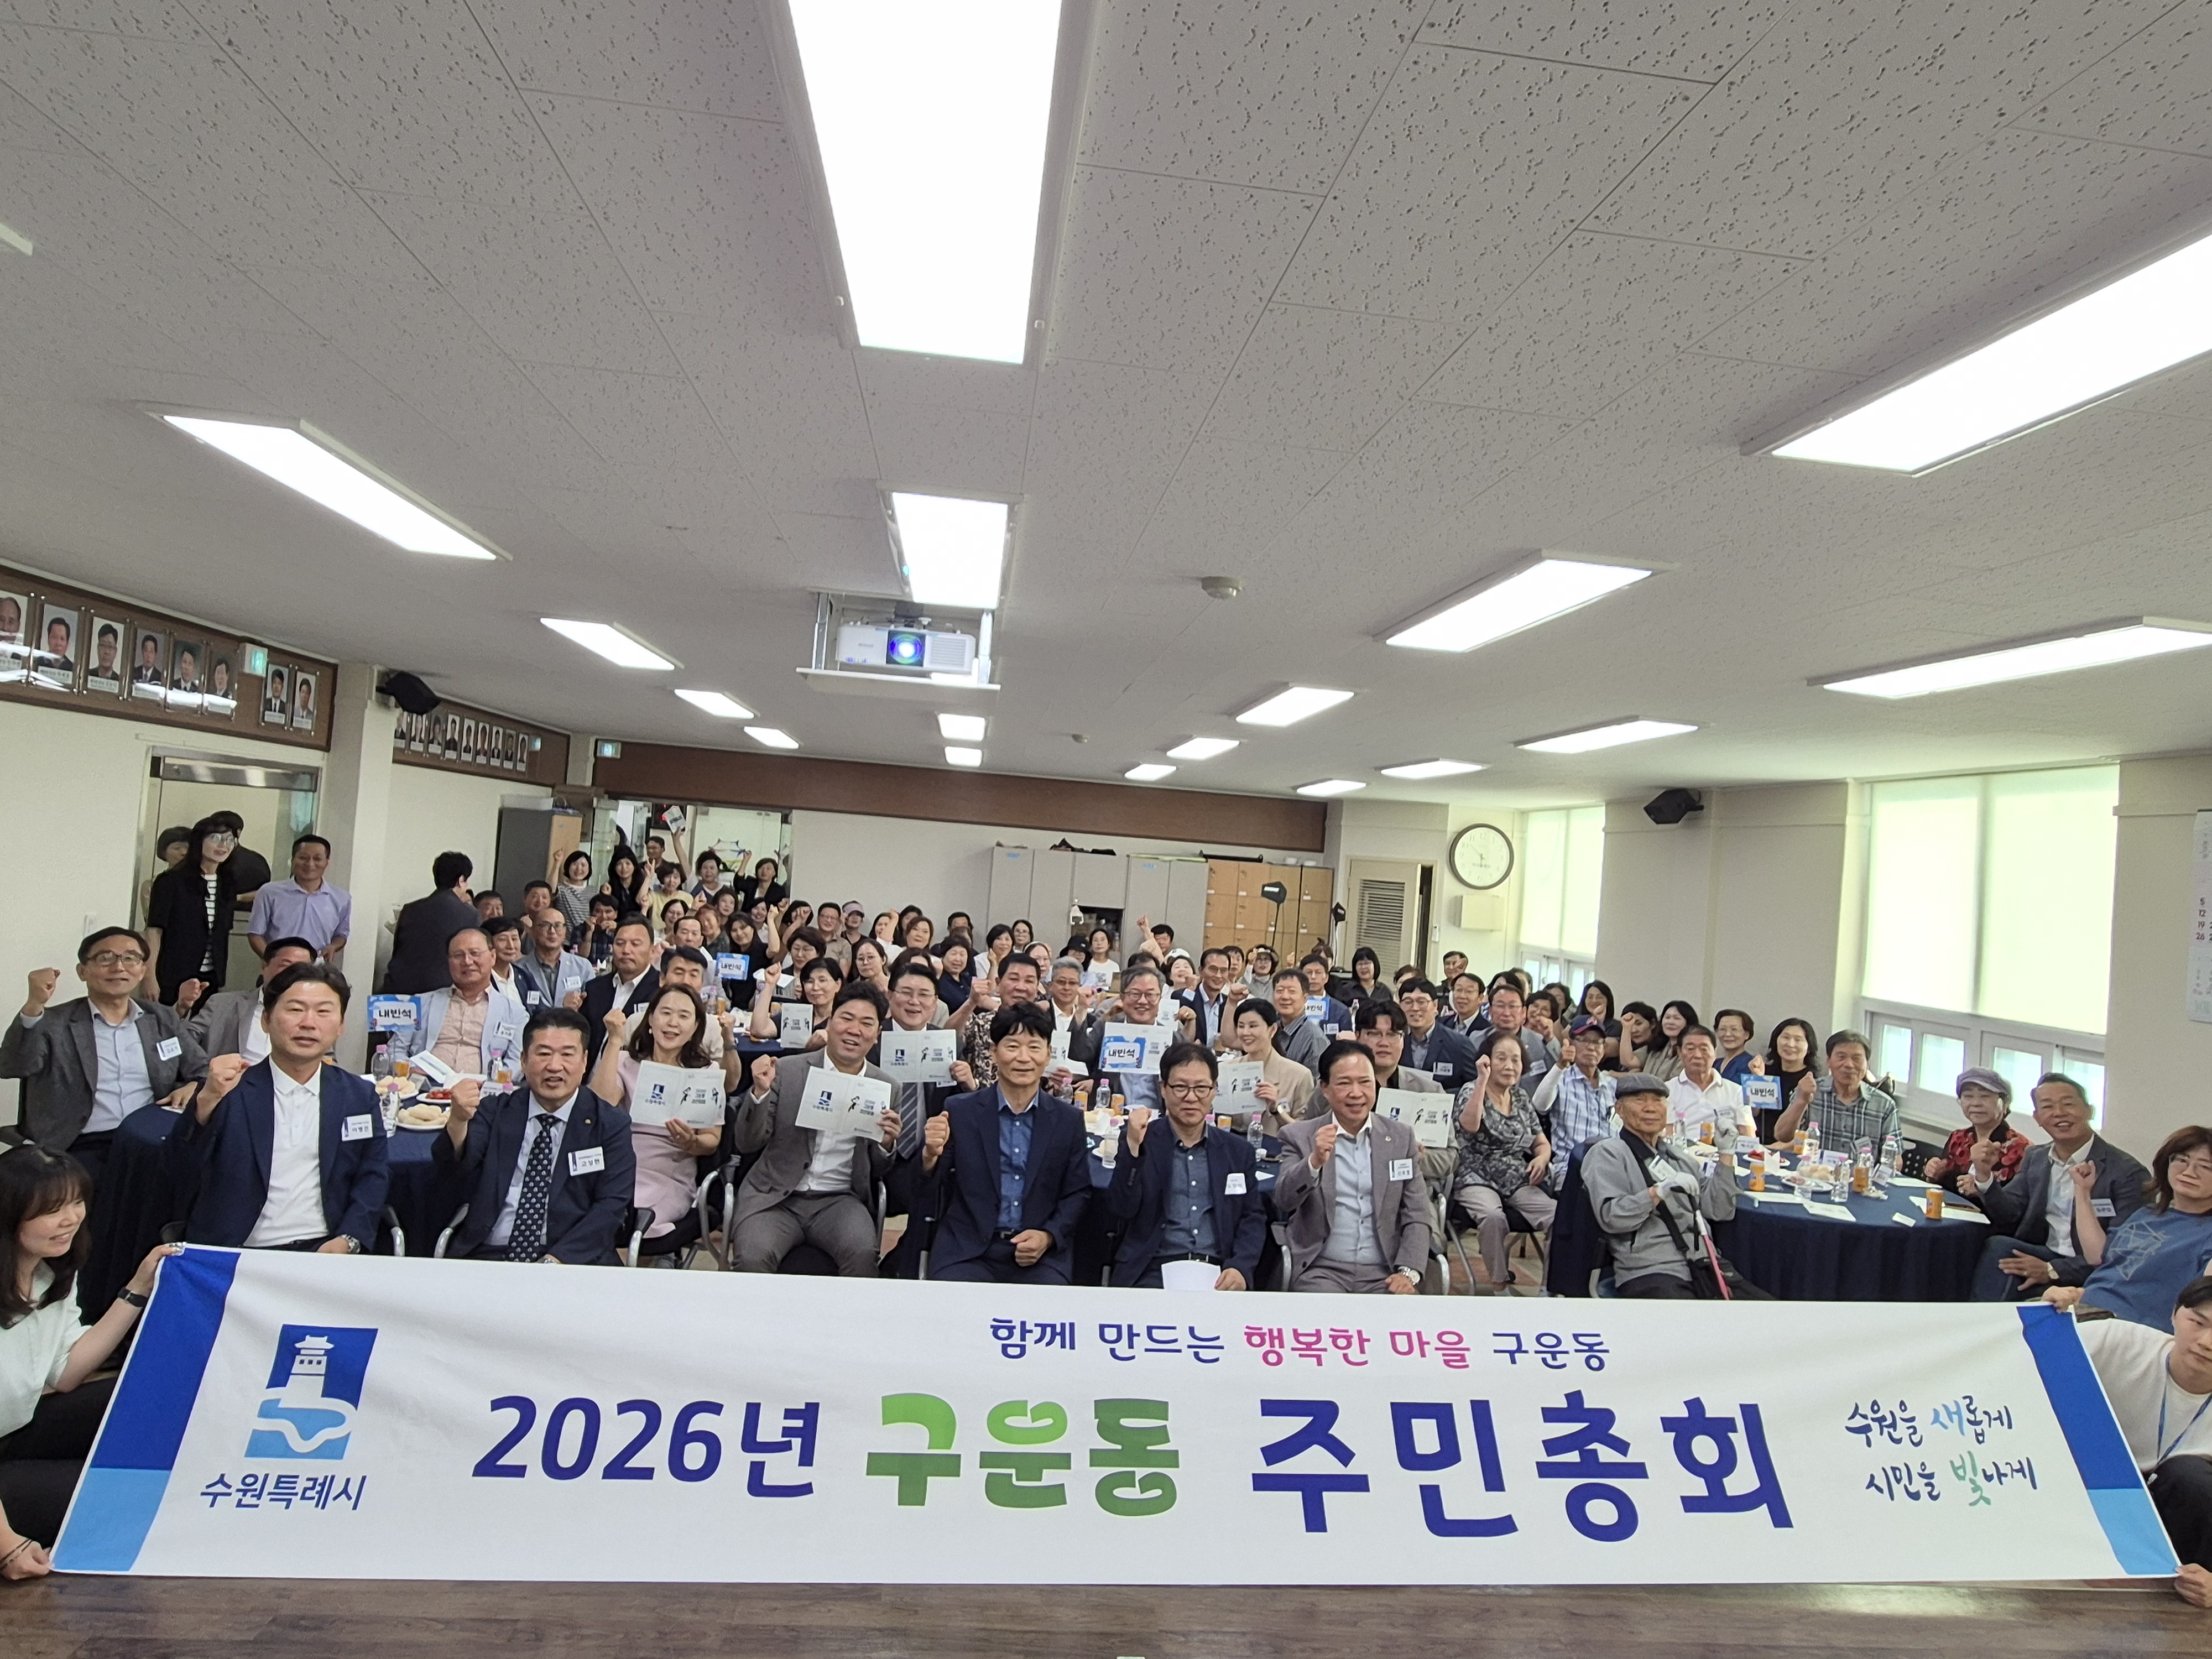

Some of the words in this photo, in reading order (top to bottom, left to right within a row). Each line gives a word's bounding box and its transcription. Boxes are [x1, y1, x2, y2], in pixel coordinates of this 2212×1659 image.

[2195, 932, 2205, 940] 26
[378, 1008, 411, 1019] 내빈석
[1108, 1048, 1135, 1058] 내빈석
[1750, 1087, 1775, 1098] 내빈석
[990, 1318, 1076, 1359] 함께
[1098, 1324, 1224, 1364] 만드는
[1244, 1325, 1371, 1366] 행복한
[1389, 1330, 1471, 1369] 마을
[1493, 1332, 1610, 1371] 구운동
[1845, 1399, 1923, 1448] 수원을
[1931, 1395, 2012, 1444] 새롭게
[472, 1396, 820, 1498] 2026년
[866, 1392, 1180, 1516] 구운동
[1252, 1389, 1793, 1542] 주민총회
[1866, 1462, 1940, 1501] 시민을
[1950, 1450, 2037, 1506] 빛나게
[200, 1473, 367, 1510] 수원특례시
